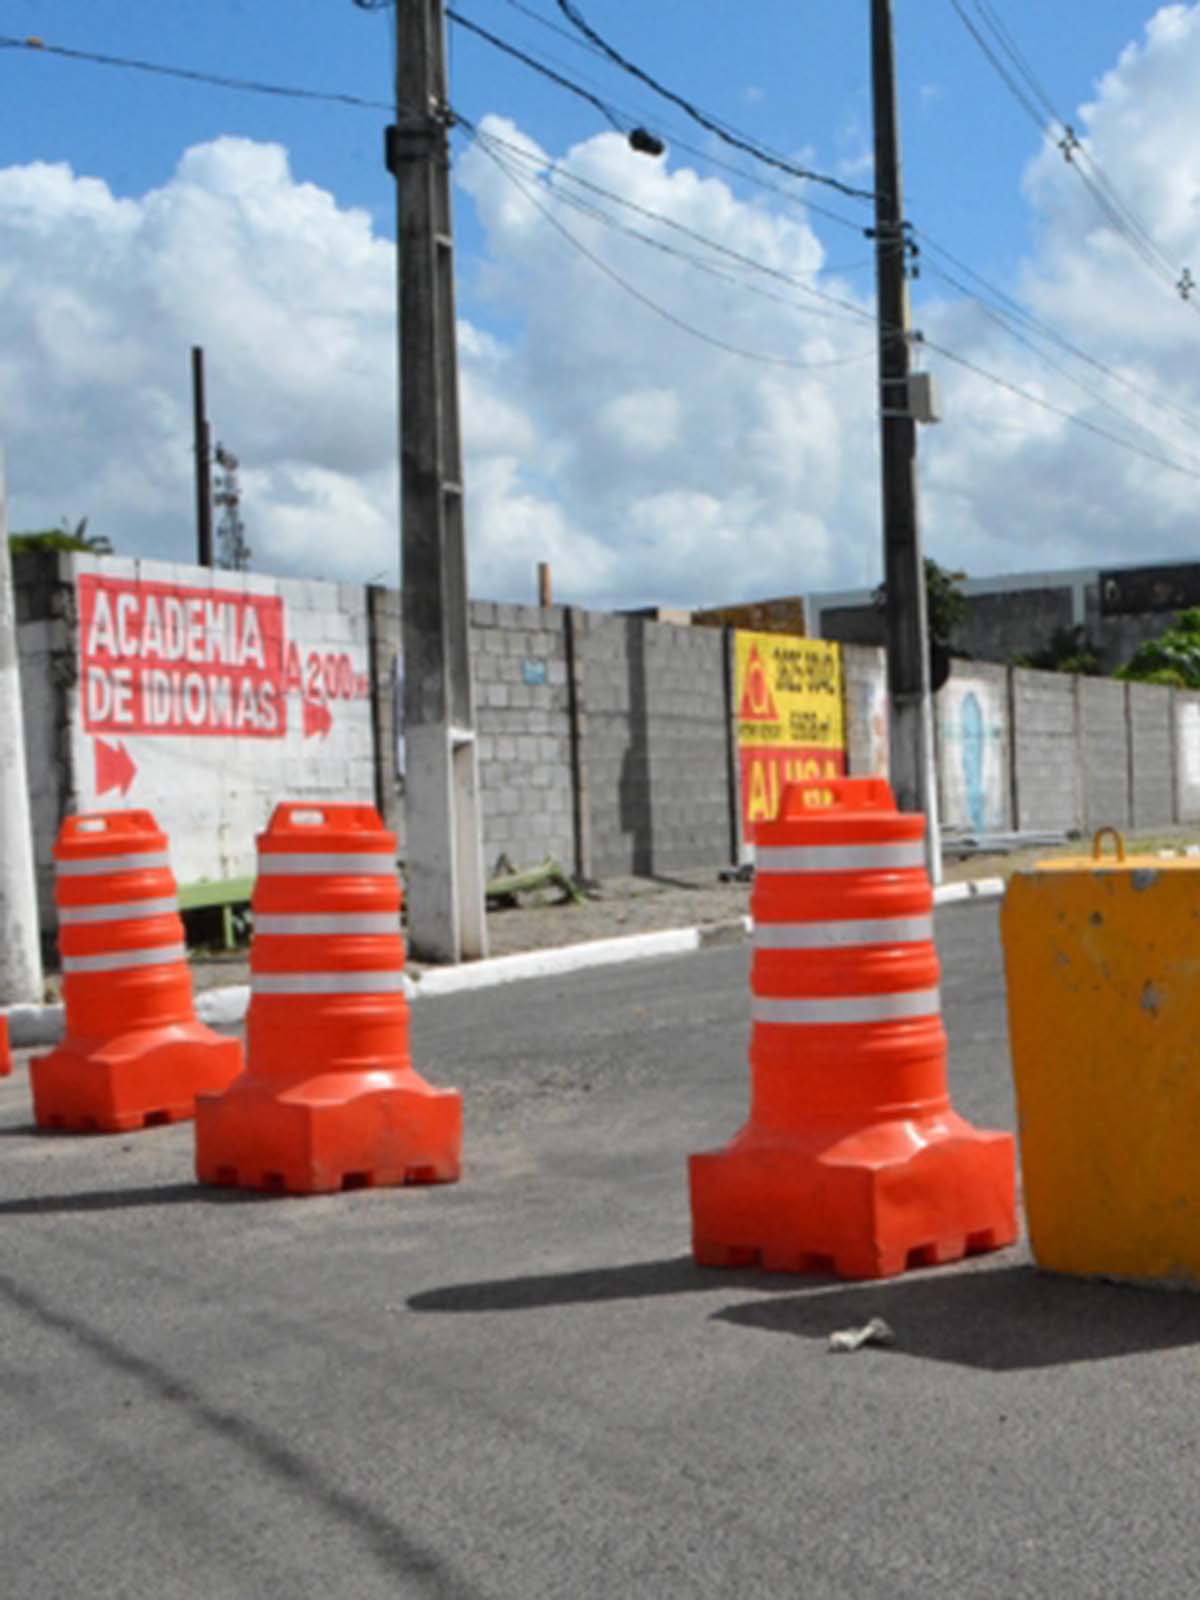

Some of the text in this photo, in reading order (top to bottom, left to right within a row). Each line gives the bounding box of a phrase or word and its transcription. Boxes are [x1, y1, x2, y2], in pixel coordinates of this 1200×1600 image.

[88, 589, 266, 669] ACADEMIA
[87, 666, 280, 730] DE IDIOMAS
